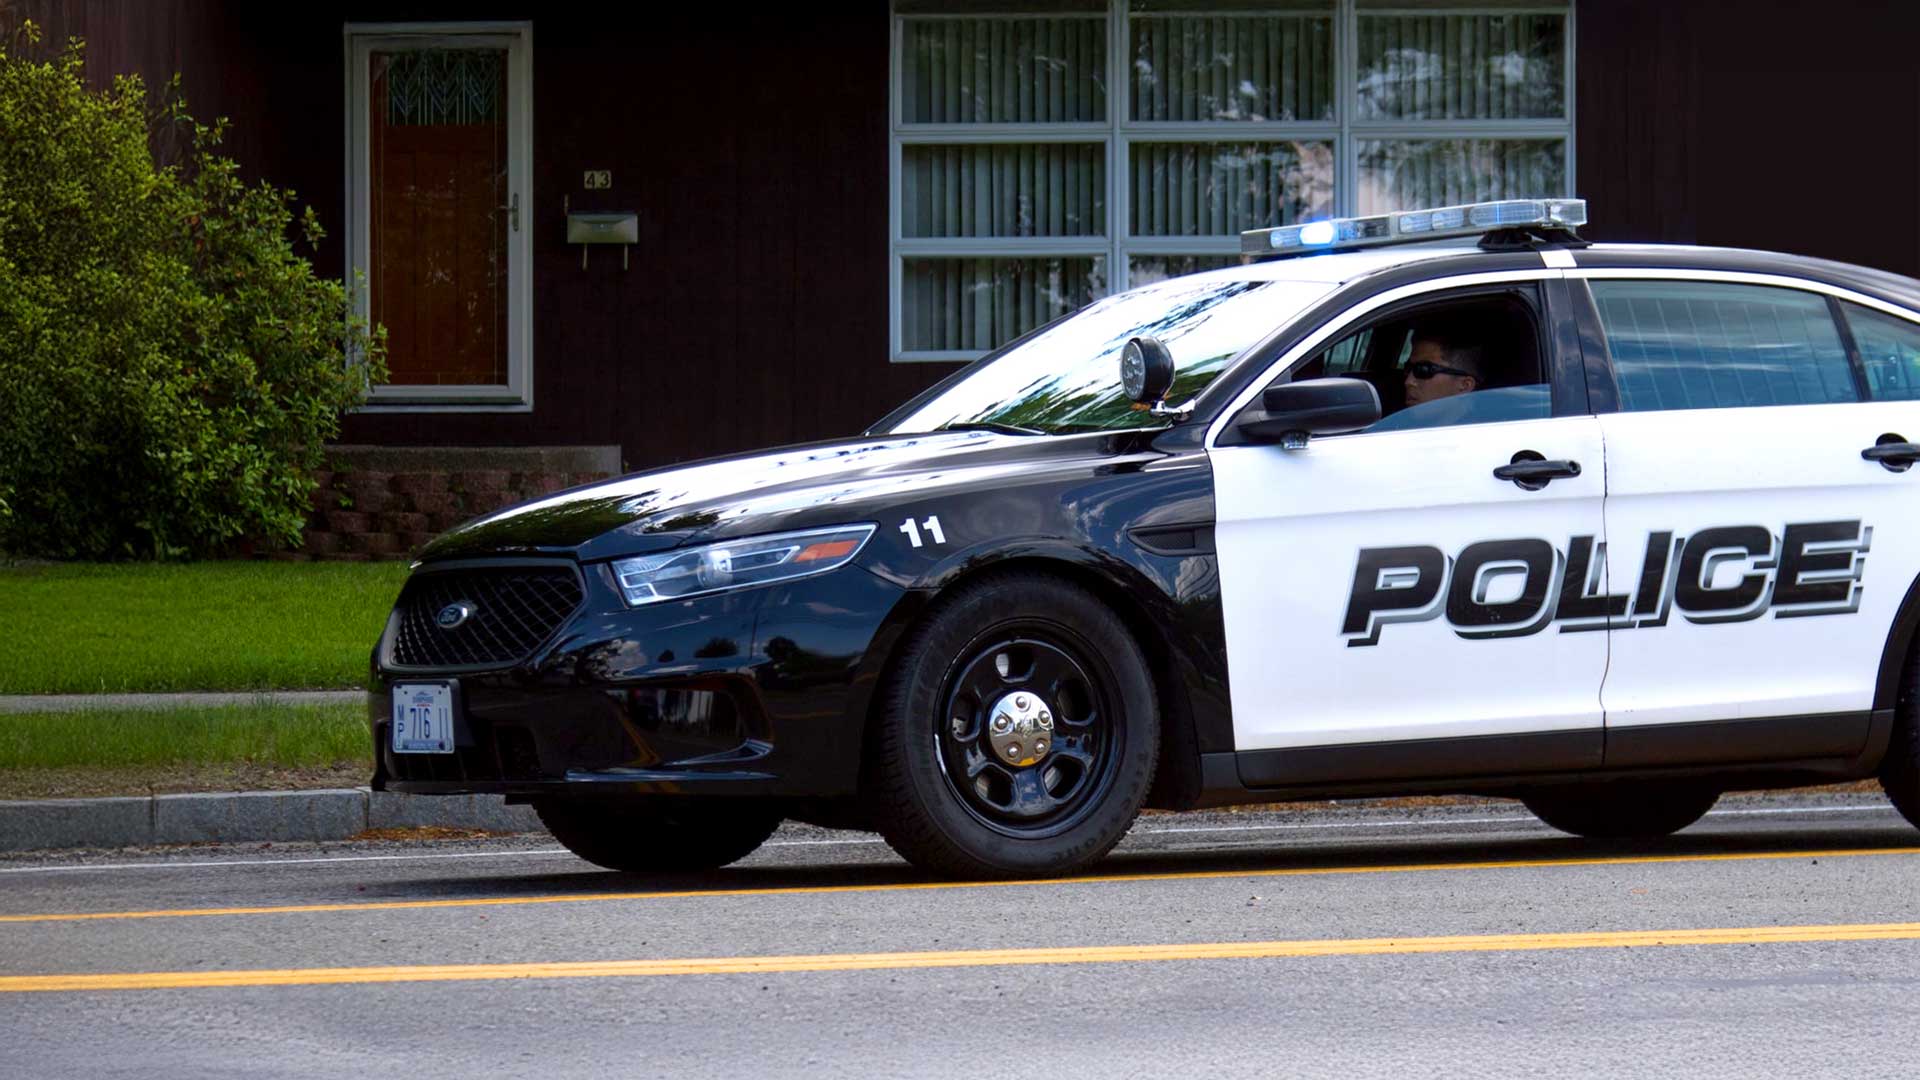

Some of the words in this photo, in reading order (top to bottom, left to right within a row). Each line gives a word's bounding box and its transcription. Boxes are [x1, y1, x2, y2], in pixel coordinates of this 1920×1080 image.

[586, 172, 609, 188] 43
[899, 515, 946, 548] 11
[1339, 519, 1873, 647] POLICE
